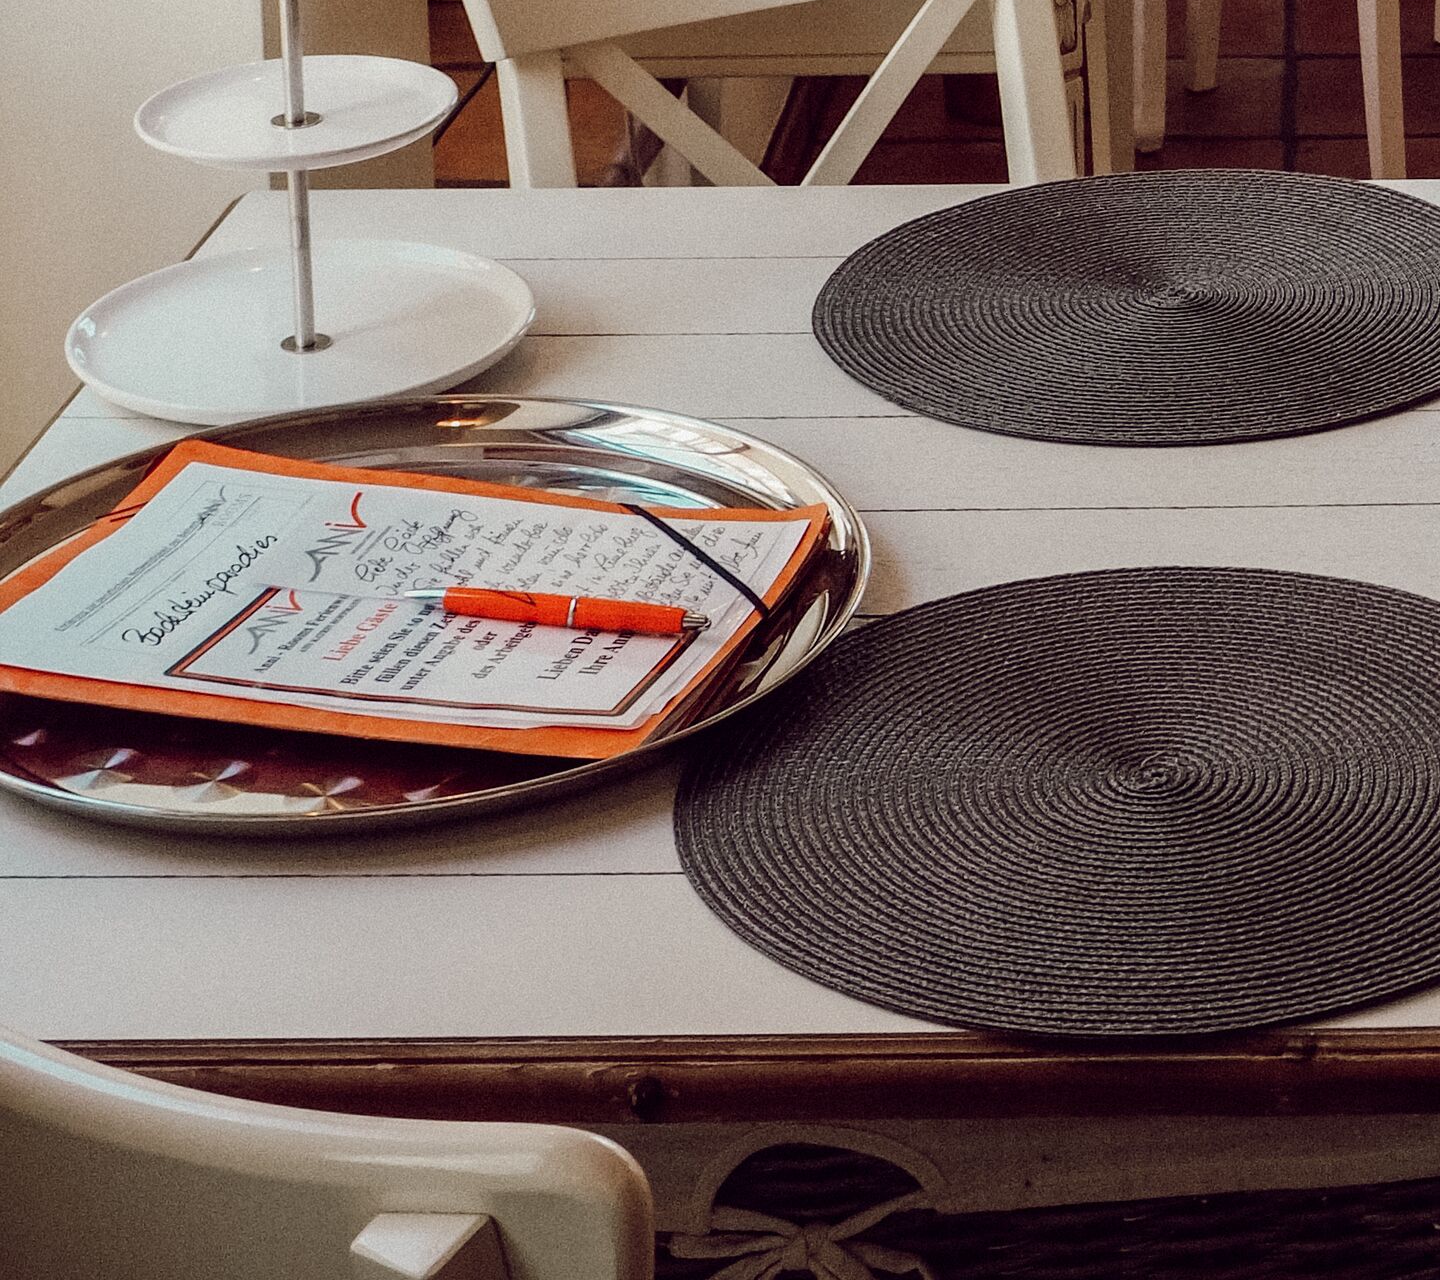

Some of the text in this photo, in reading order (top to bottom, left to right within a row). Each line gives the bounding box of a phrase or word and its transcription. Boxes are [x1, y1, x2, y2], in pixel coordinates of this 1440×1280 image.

[322, 603, 397, 660] Liebe Gäste
[473, 631, 497, 650] oder
[339, 664, 373, 684] Bitte
[368, 642, 397, 662] seien
[387, 628, 412, 641] Sie
[374, 658, 411, 682] füllen
[403, 631, 439, 657] diesen
[400, 620, 481, 690] unter Angabe des
[471, 665, 495, 678] des
[537, 647, 584, 679] Lieben
[578, 654, 613, 674] Ihre
